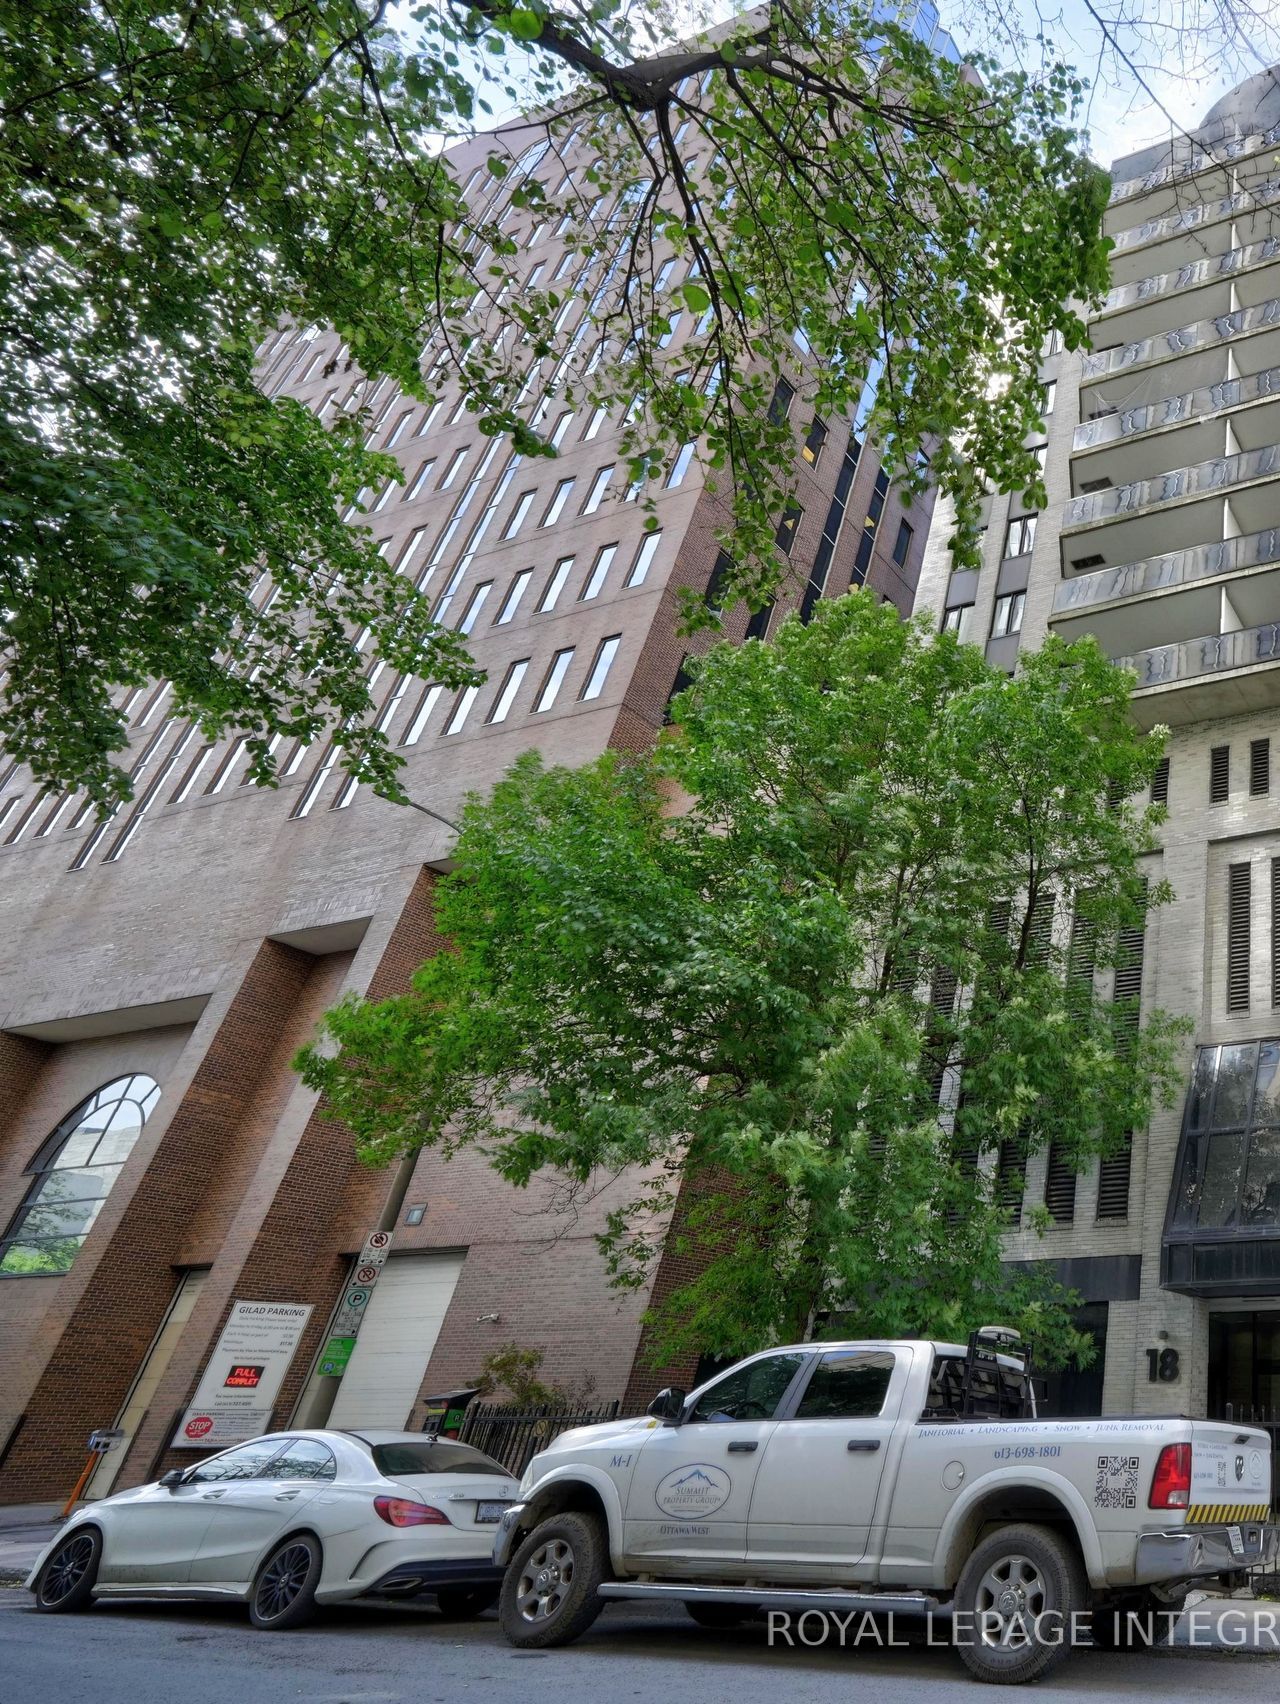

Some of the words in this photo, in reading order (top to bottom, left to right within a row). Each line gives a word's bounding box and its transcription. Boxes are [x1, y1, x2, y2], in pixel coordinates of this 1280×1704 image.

[239, 1306, 266, 1314] GILAD
[267, 1307, 306, 1317] PARKING
[1145, 1348, 1180, 1383] 18
[234, 1368, 256, 1377] FULL
[226, 1377, 258, 1385] COMPLET
[189, 1421, 211, 1430] STOP
[919, 1428, 966, 1438] JANITORIAL
[978, 1425, 1039, 1434] LANDSCAPING
[1054, 1424, 1082, 1432] SNOW
[1095, 1423, 1119, 1433] JUNK
[1121, 1423, 1166, 1432] REMOVAL
[994, 1446, 1062, 1459] 613-698-1801
[676, 1486, 710, 1495] SUMMIT
[663, 1496, 693, 1504] PROPERTY
[660, 1525, 690, 1535] OTTAWA
[691, 1525, 710, 1535] WEST
